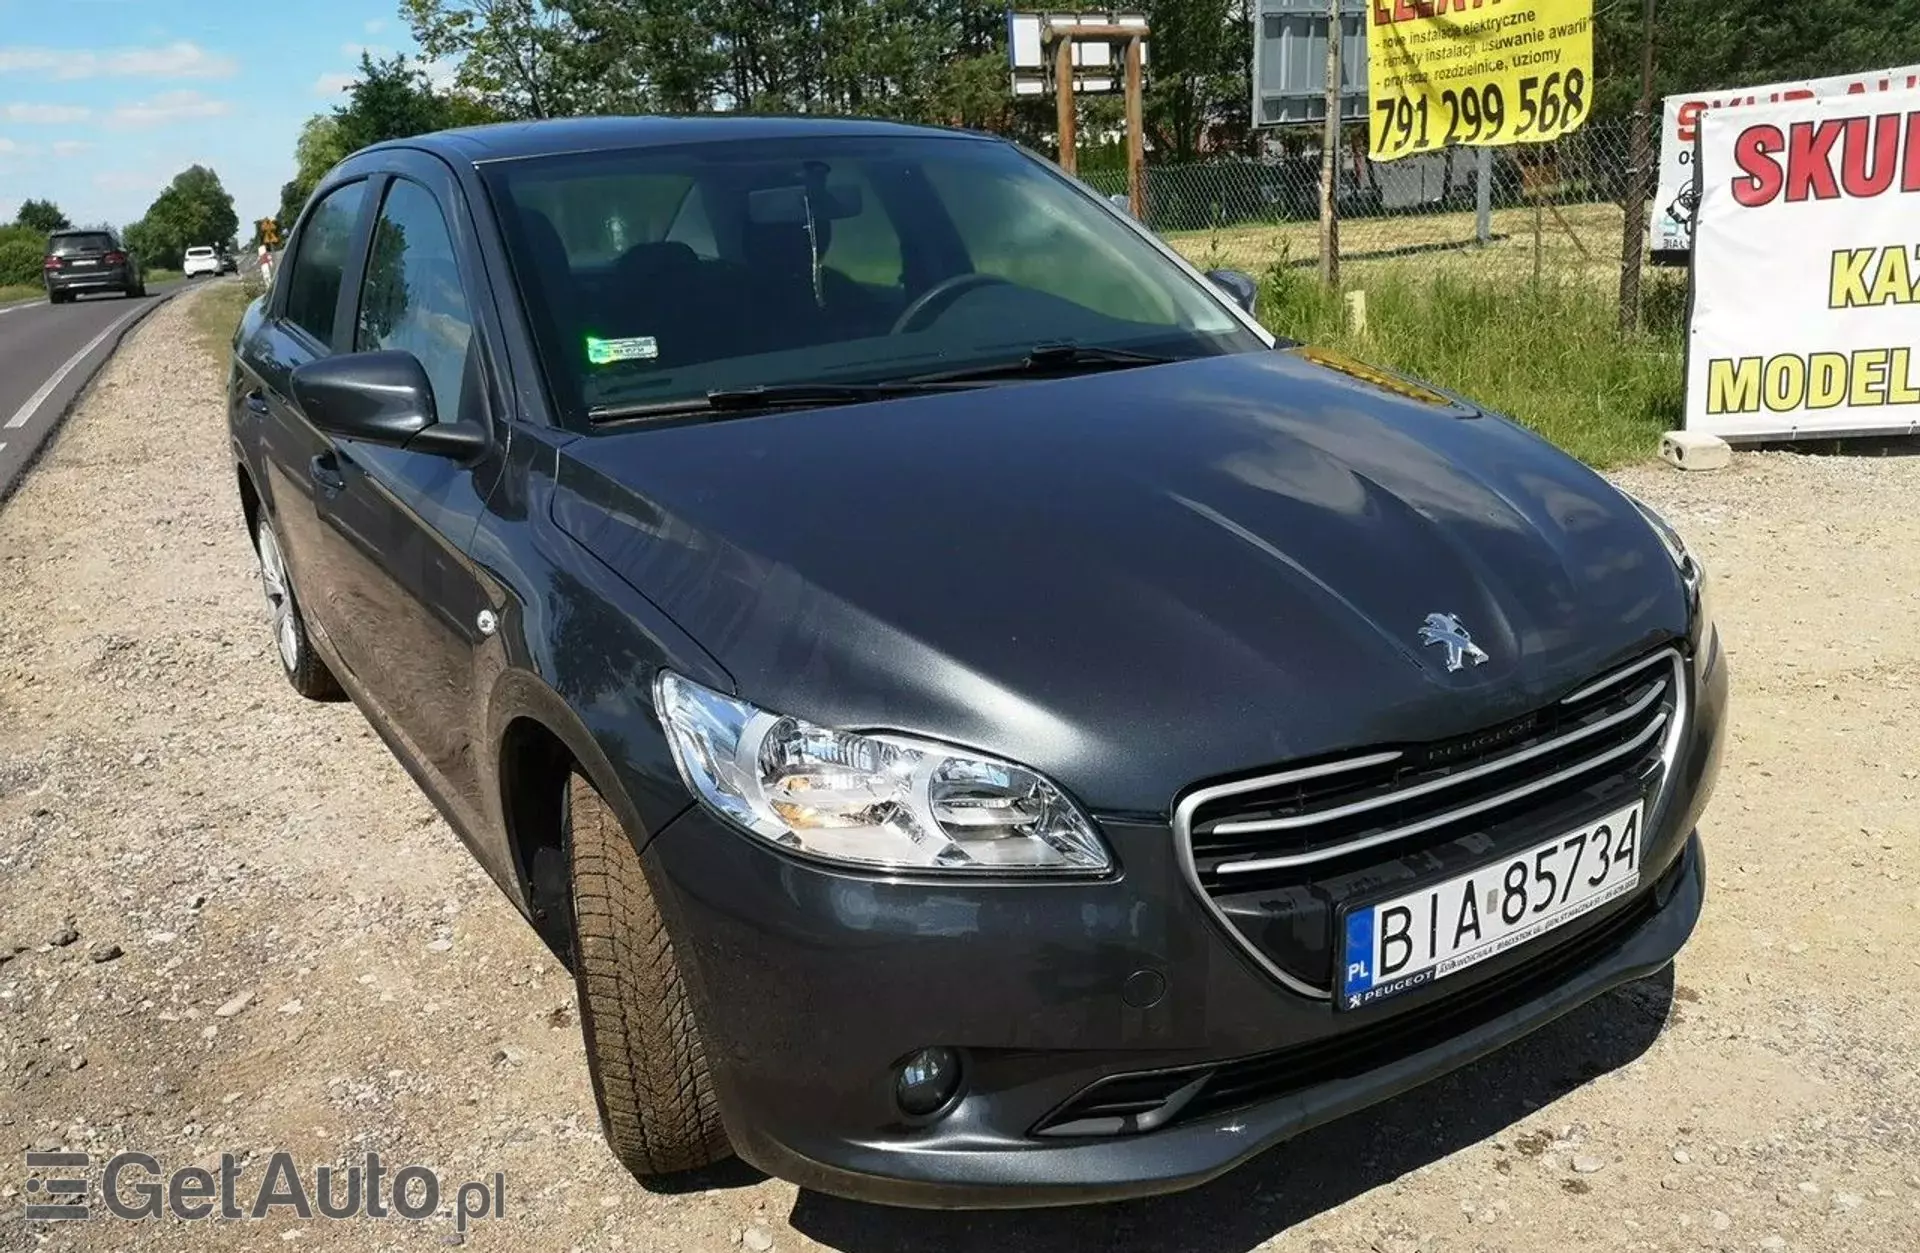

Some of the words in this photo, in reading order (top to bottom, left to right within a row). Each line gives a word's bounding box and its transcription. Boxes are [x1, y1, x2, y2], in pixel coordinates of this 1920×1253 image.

[1410, 25, 1461, 44] instalacje
[1464, 10, 1536, 36] elektryczne
[1482, 28, 1545, 52] usuwanie
[1548, 18, 1587, 40] awarii
[1434, 58, 1509, 81] rozdzielnice,
[1512, 48, 1562, 68] uziomy
[1376, 93, 1430, 153] 791
[1441, 83, 1505, 146] 299
[1513, 67, 1584, 136] 568
[1379, 879, 1482, 977] BIA
[1502, 809, 1638, 926] 85734
[1348, 960, 1370, 982] PL
[1364, 968, 1434, 1001] PEUGEOT
